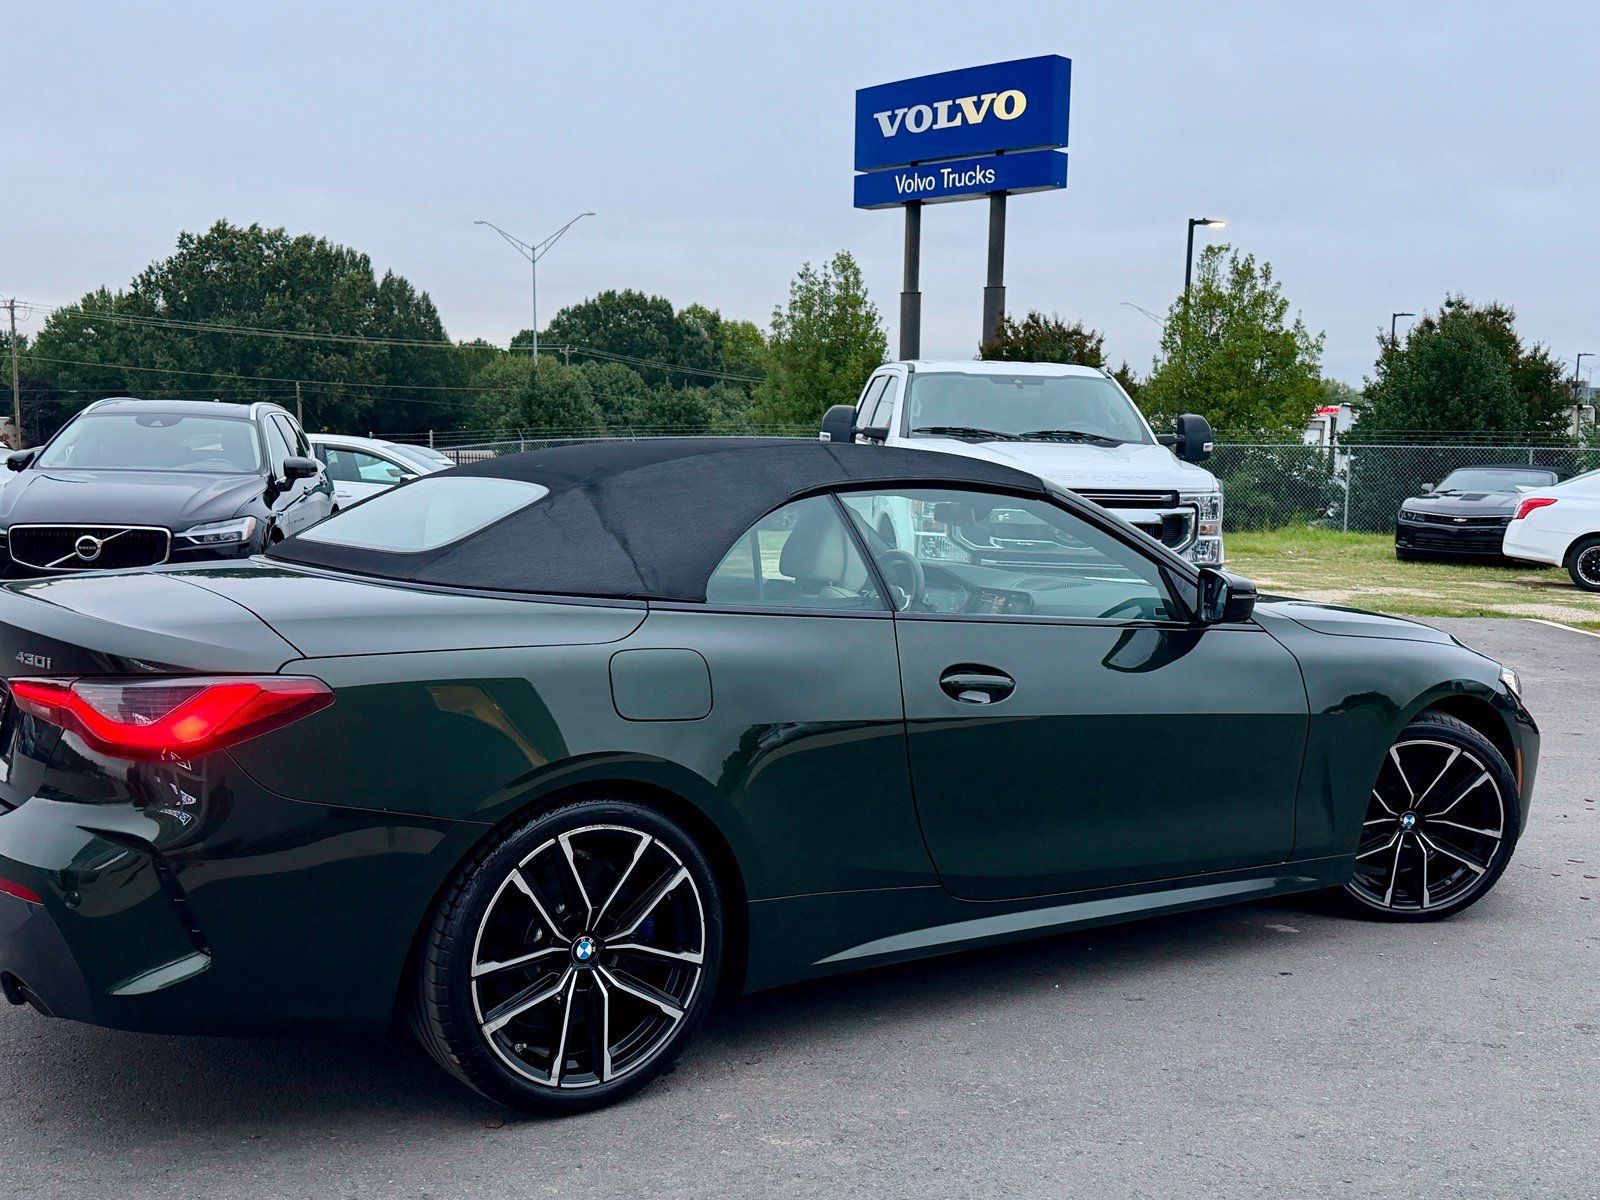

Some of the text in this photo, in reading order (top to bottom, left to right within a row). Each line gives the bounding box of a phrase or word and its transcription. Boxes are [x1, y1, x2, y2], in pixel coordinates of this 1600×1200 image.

[873, 89, 1027, 138] VOLVO
[895, 165, 996, 194] Volvo Trucks
[15, 651, 52, 669] 430i
